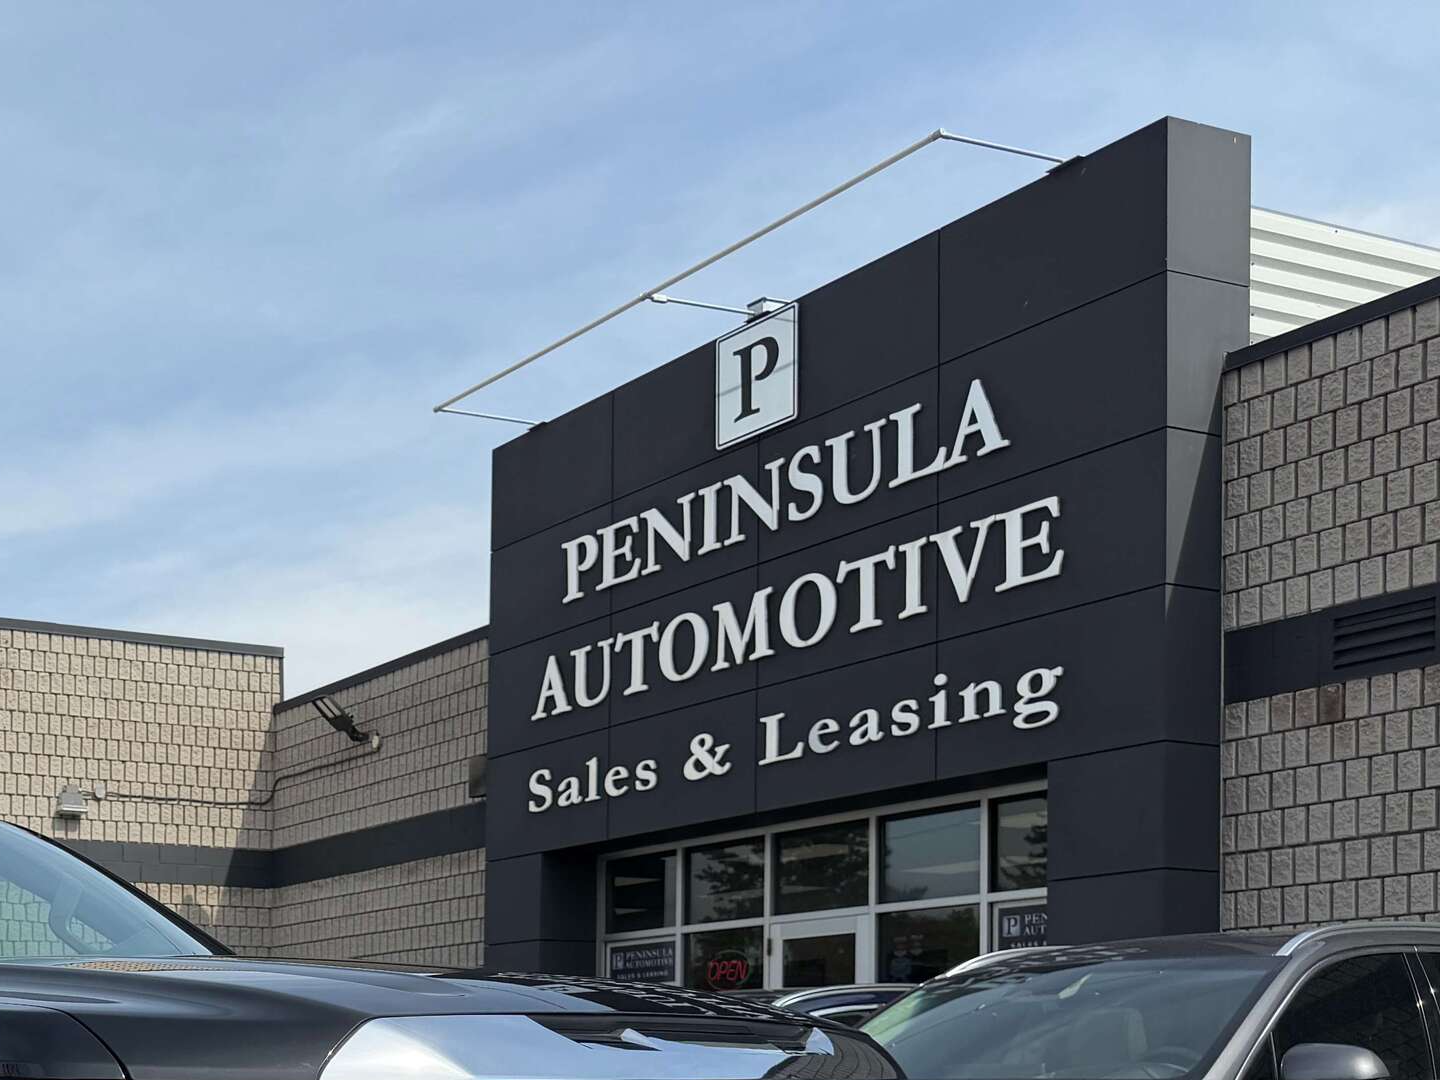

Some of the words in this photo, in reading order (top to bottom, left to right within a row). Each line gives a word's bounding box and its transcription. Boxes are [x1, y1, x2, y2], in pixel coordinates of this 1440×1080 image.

[733, 336, 779, 423] P
[561, 378, 1010, 603] PENINSULA
[531, 495, 1064, 721] AUTOMOTIVE
[527, 755, 658, 813] Sales
[683, 731, 732, 782] &
[758, 665, 1064, 767] Leasing
[626, 948, 673, 960] PENINSULA
[626, 957, 673, 969] AUTOMOTIVE
[707, 959, 748, 981] OPEN
